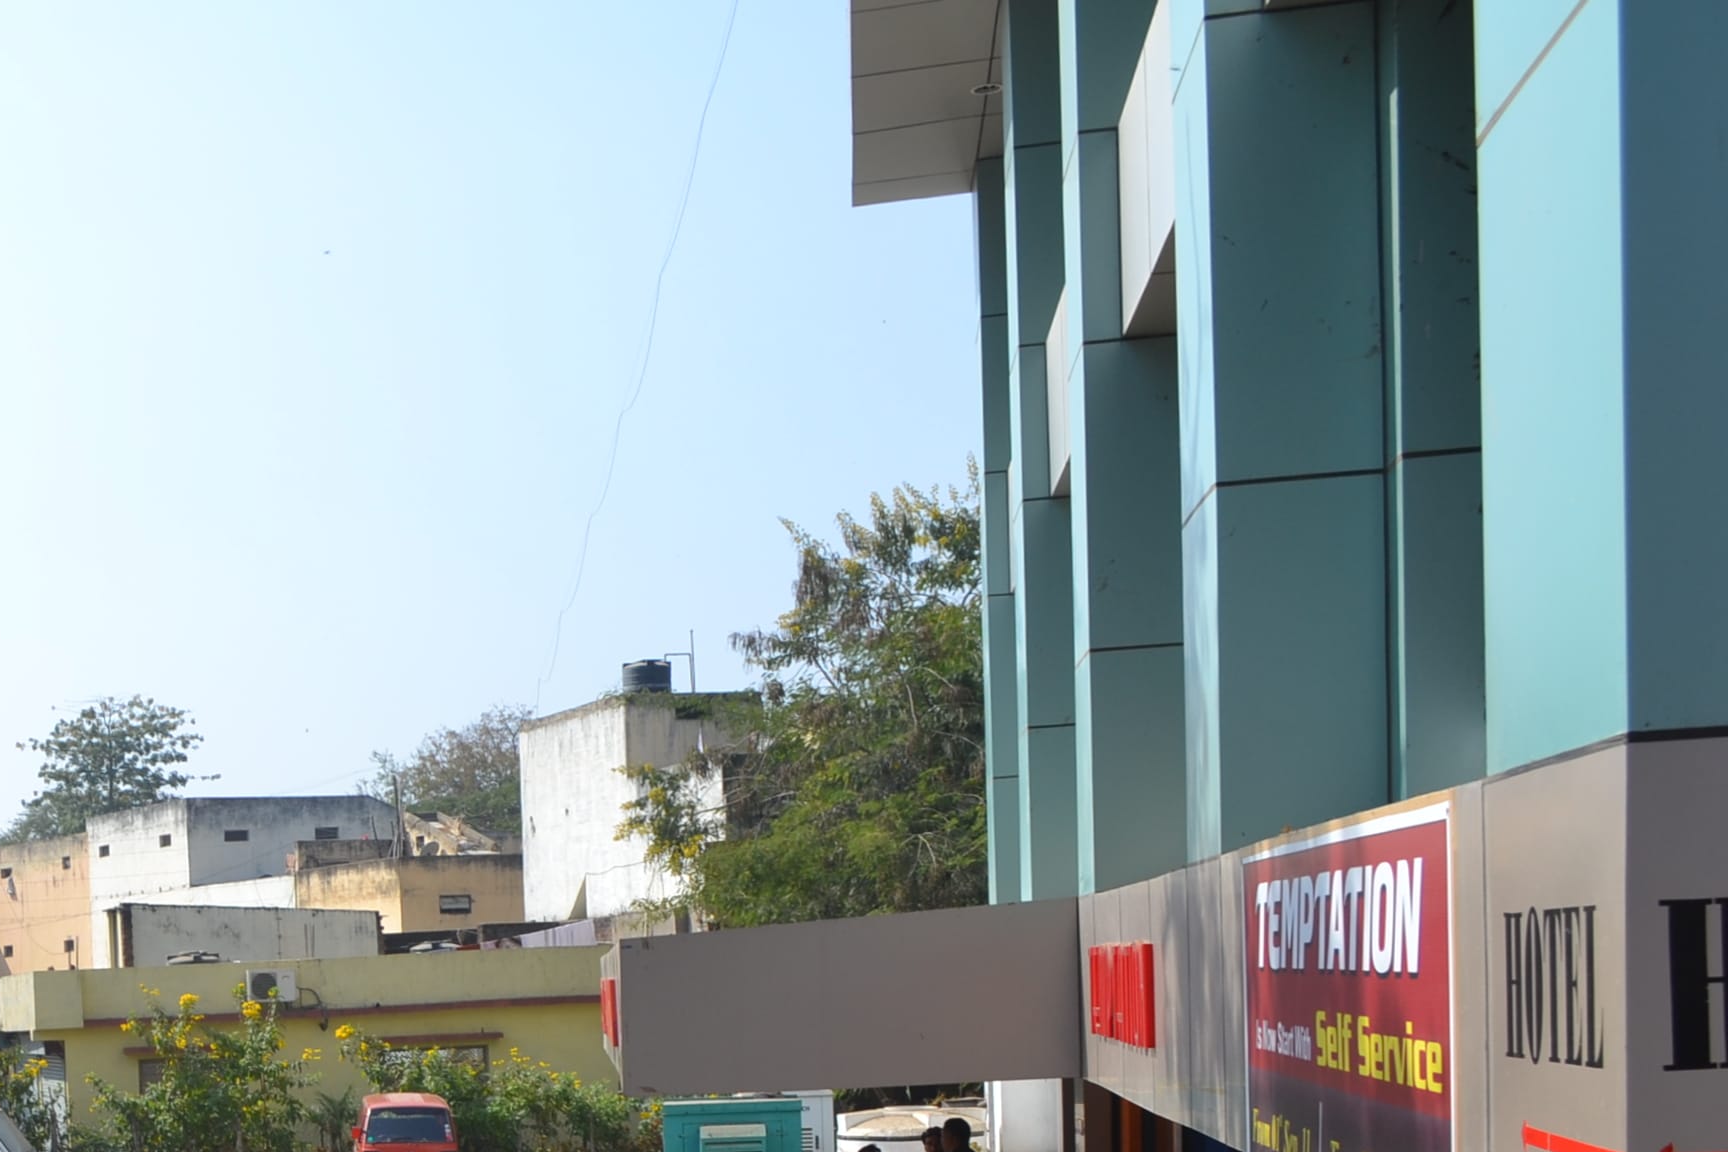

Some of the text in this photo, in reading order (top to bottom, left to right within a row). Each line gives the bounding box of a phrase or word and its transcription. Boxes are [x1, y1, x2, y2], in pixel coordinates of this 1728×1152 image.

[1255, 857, 1423, 975] TEMPTATION
[1503, 905, 1604, 1069] HOTEL
[1315, 1010, 1351, 1072] Self
[1357, 1015, 1443, 1094] Service
